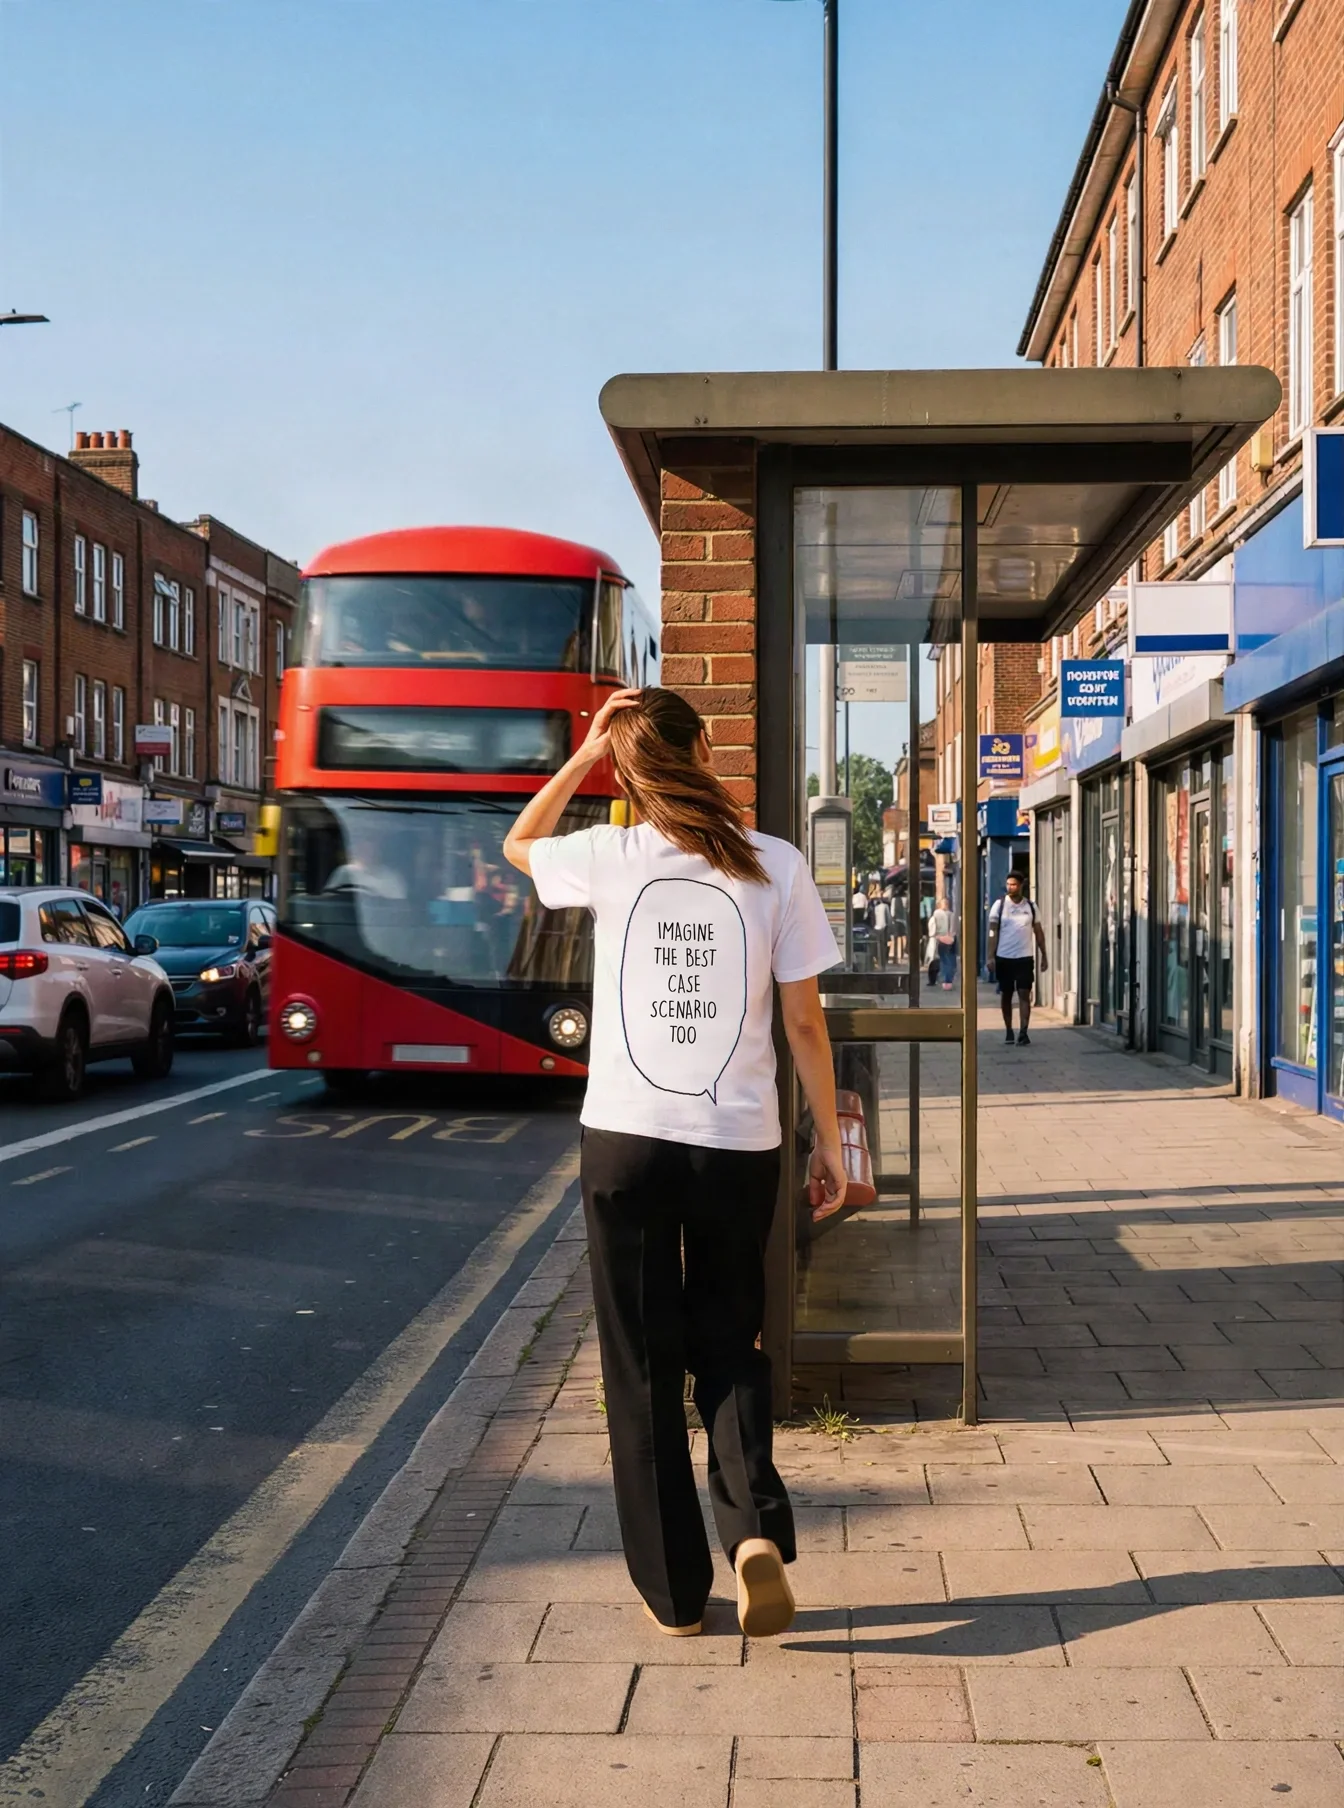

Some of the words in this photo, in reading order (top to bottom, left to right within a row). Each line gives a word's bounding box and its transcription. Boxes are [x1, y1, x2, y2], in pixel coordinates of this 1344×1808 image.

[658, 922, 714, 941] IMAGINE
[654, 947, 677, 965] THE
[686, 948, 716, 967] BEST
[668, 974, 700, 993] CASE
[651, 1000, 716, 1019] SCENARIO
[670, 1026, 696, 1044] TOO
[243, 1113, 533, 1143] BUS
